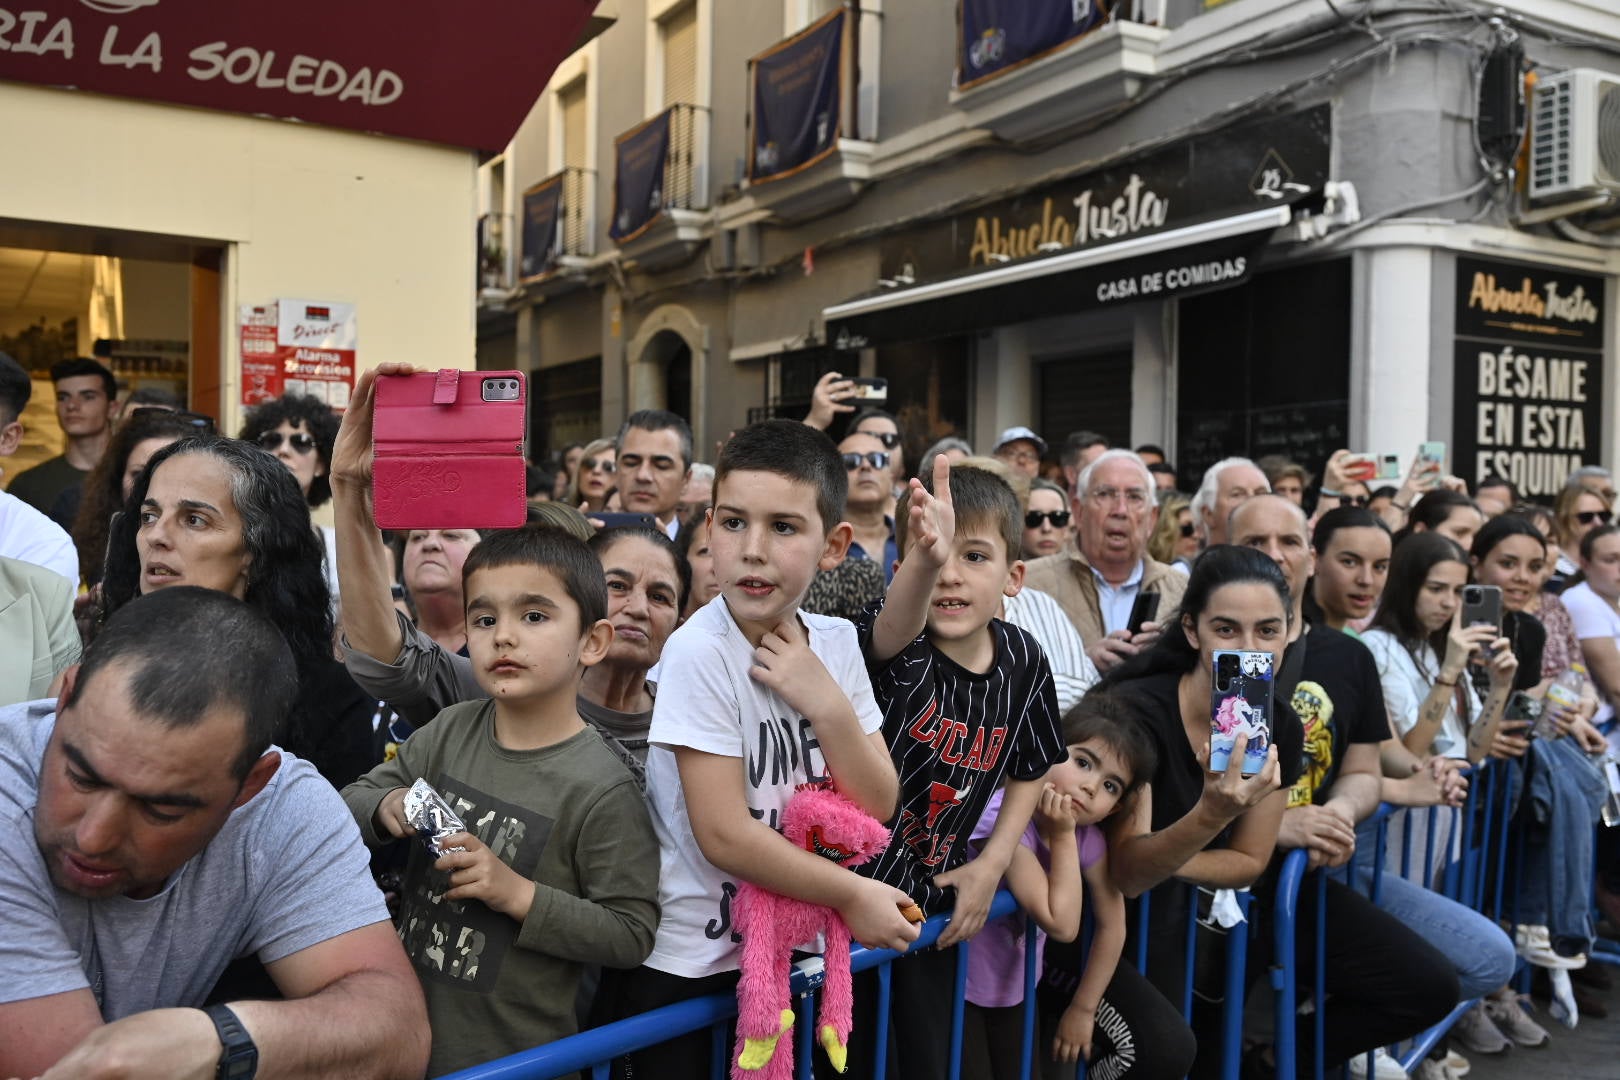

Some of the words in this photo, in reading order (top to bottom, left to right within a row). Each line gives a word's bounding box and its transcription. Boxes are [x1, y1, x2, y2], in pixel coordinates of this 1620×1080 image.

[99, 24, 163, 73] LA
[186, 41, 404, 105] SOLEDAD
[969, 197, 1075, 267] Abuela
[1073, 173, 1169, 244] Justa
[1097, 282, 1138, 301] CASA
[1141, 271, 1163, 294] DE
[1165, 256, 1247, 290] COMIDAS
[1477, 345, 1588, 403] BÉSAME
[1477, 401, 1515, 447] EN
[1521, 404, 1586, 450] ESTA
